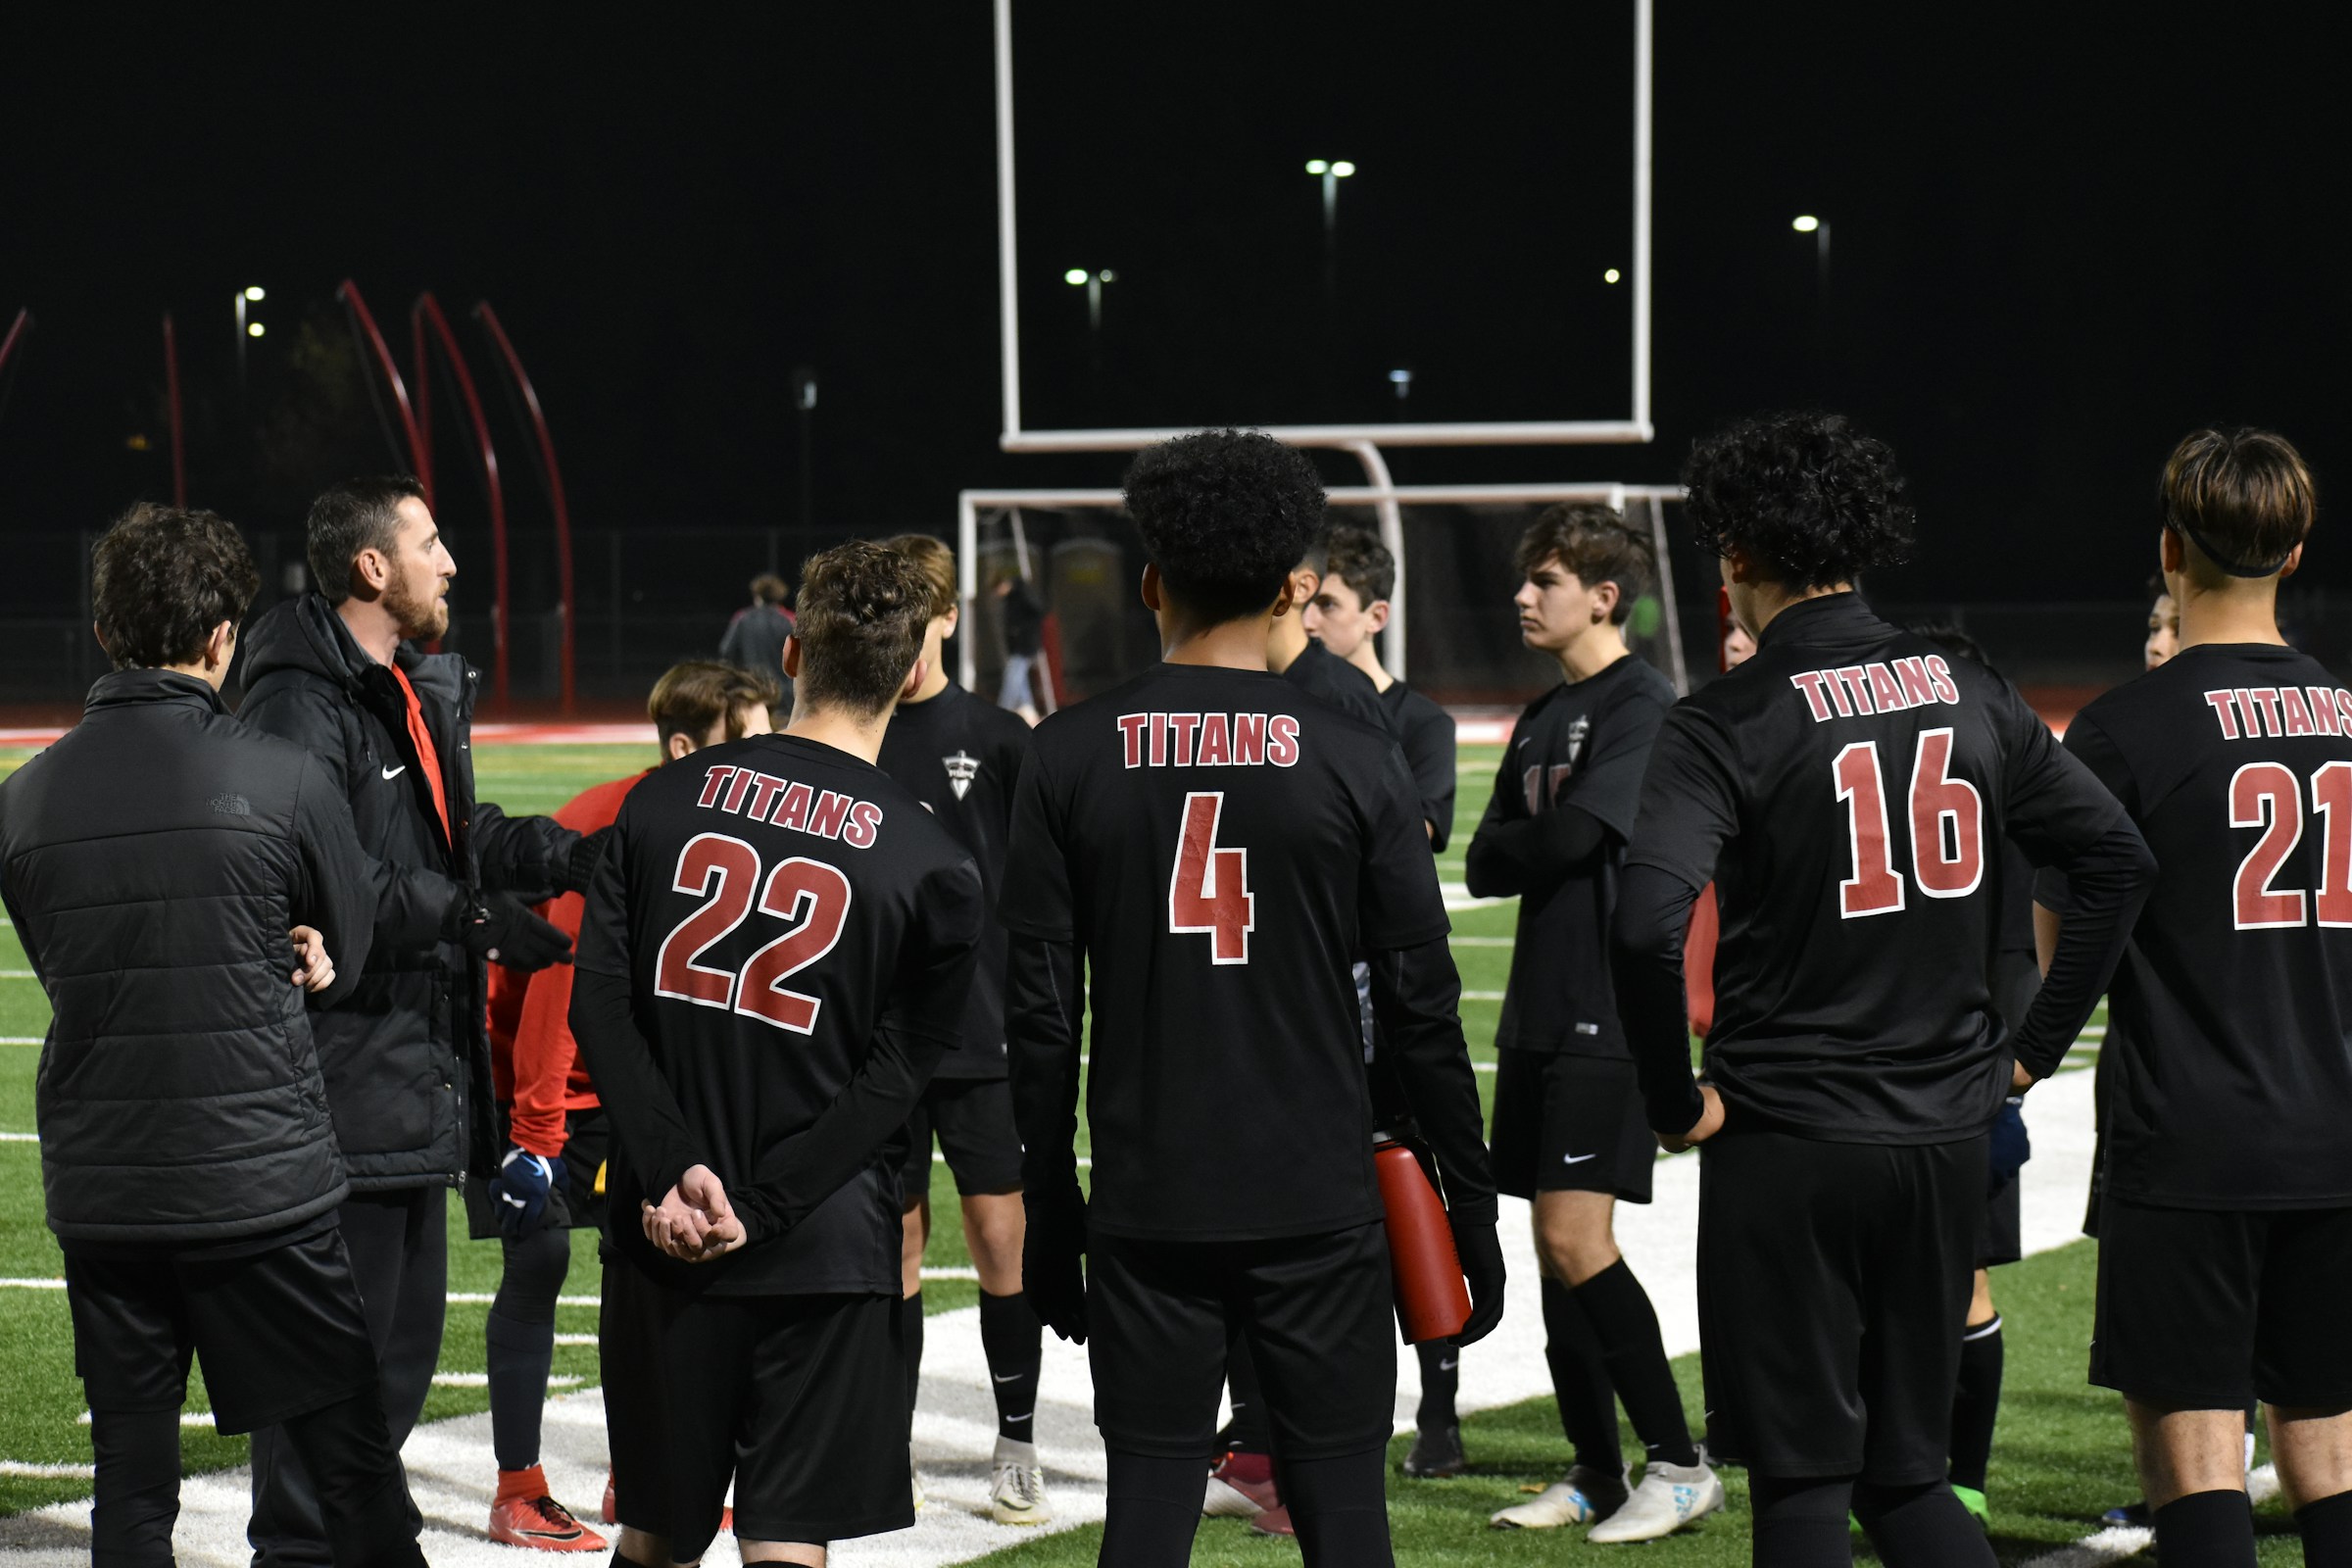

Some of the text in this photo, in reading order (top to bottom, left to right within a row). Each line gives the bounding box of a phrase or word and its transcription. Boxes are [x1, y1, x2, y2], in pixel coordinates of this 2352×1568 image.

[1789, 655, 1960, 723] TITANS
[2204, 687, 2352, 741] TITANS
[1117, 711, 1300, 769] TITANS
[215, 806, 236, 814] FACE
[220, 792, 236, 801] THE
[696, 764, 884, 850] TITANS
[1831, 726, 1984, 920] 16
[1168, 791, 1255, 966] 4
[2229, 760, 2352, 931] 21
[654, 831, 853, 1037] 22
